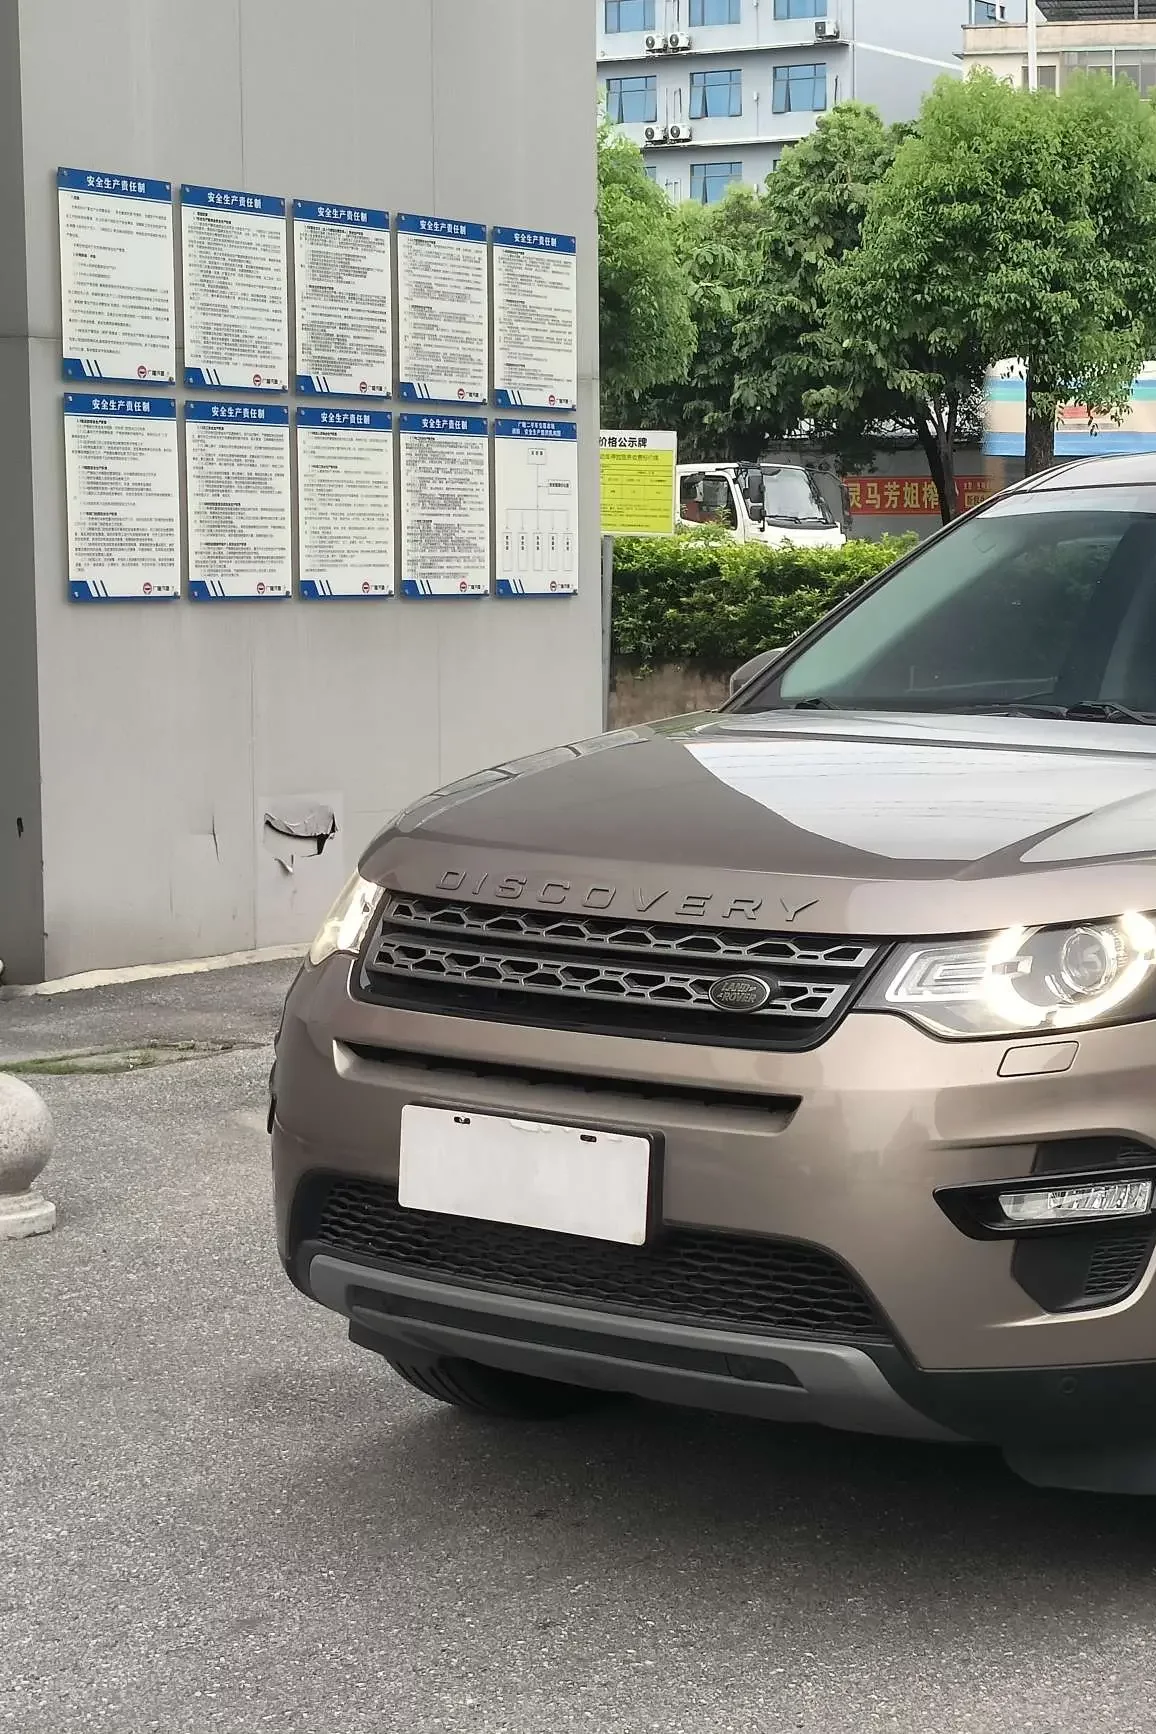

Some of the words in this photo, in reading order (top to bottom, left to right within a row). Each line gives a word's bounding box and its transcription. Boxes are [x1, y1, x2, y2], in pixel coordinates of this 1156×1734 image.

[86, 176, 146, 194] 安全生产责任制
[207, 191, 262, 210] 安全生产责任制
[317, 207, 367, 223] 安全生产责任制
[420, 220, 467, 236] 安全生产责任制
[513, 233, 557, 248] 安全生产责任制
[92, 398, 151, 413] 安全生产责任制
[211, 405, 266, 420] 安全生产责任制
[320, 411, 371, 426] 安全生产责任制
[421, 418, 468, 432] 安全生产责任制
[436, 871, 820, 921] DISCOVERY
[720, 982, 750, 993] LAND
[721, 991, 757, 1003] ROVER
